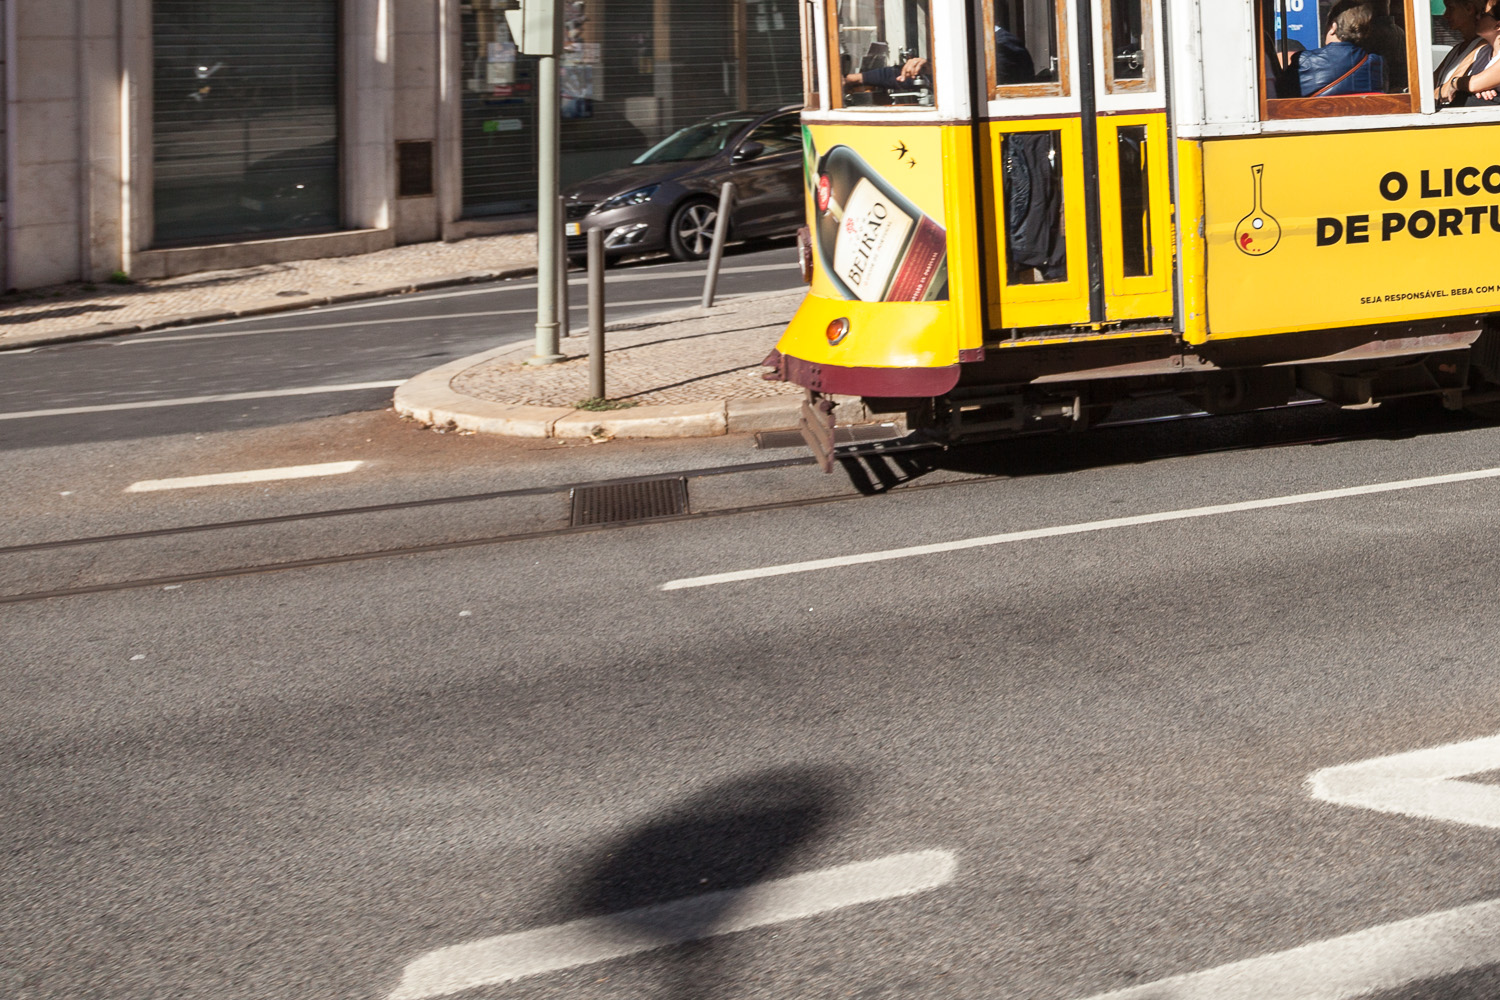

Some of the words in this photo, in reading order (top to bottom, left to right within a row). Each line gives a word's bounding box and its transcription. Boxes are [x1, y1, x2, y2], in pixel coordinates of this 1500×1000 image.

[1379, 171, 1408, 201] O
[848, 202, 888, 286] BEIRÃO
[1316, 214, 1370, 247] DE
[1360, 295, 1382, 304] SEJA
[1384, 290, 1449, 302] RESPONSÁVEL.
[1451, 287, 1474, 297] BEBA
[1476, 284, 1495, 294] COM
